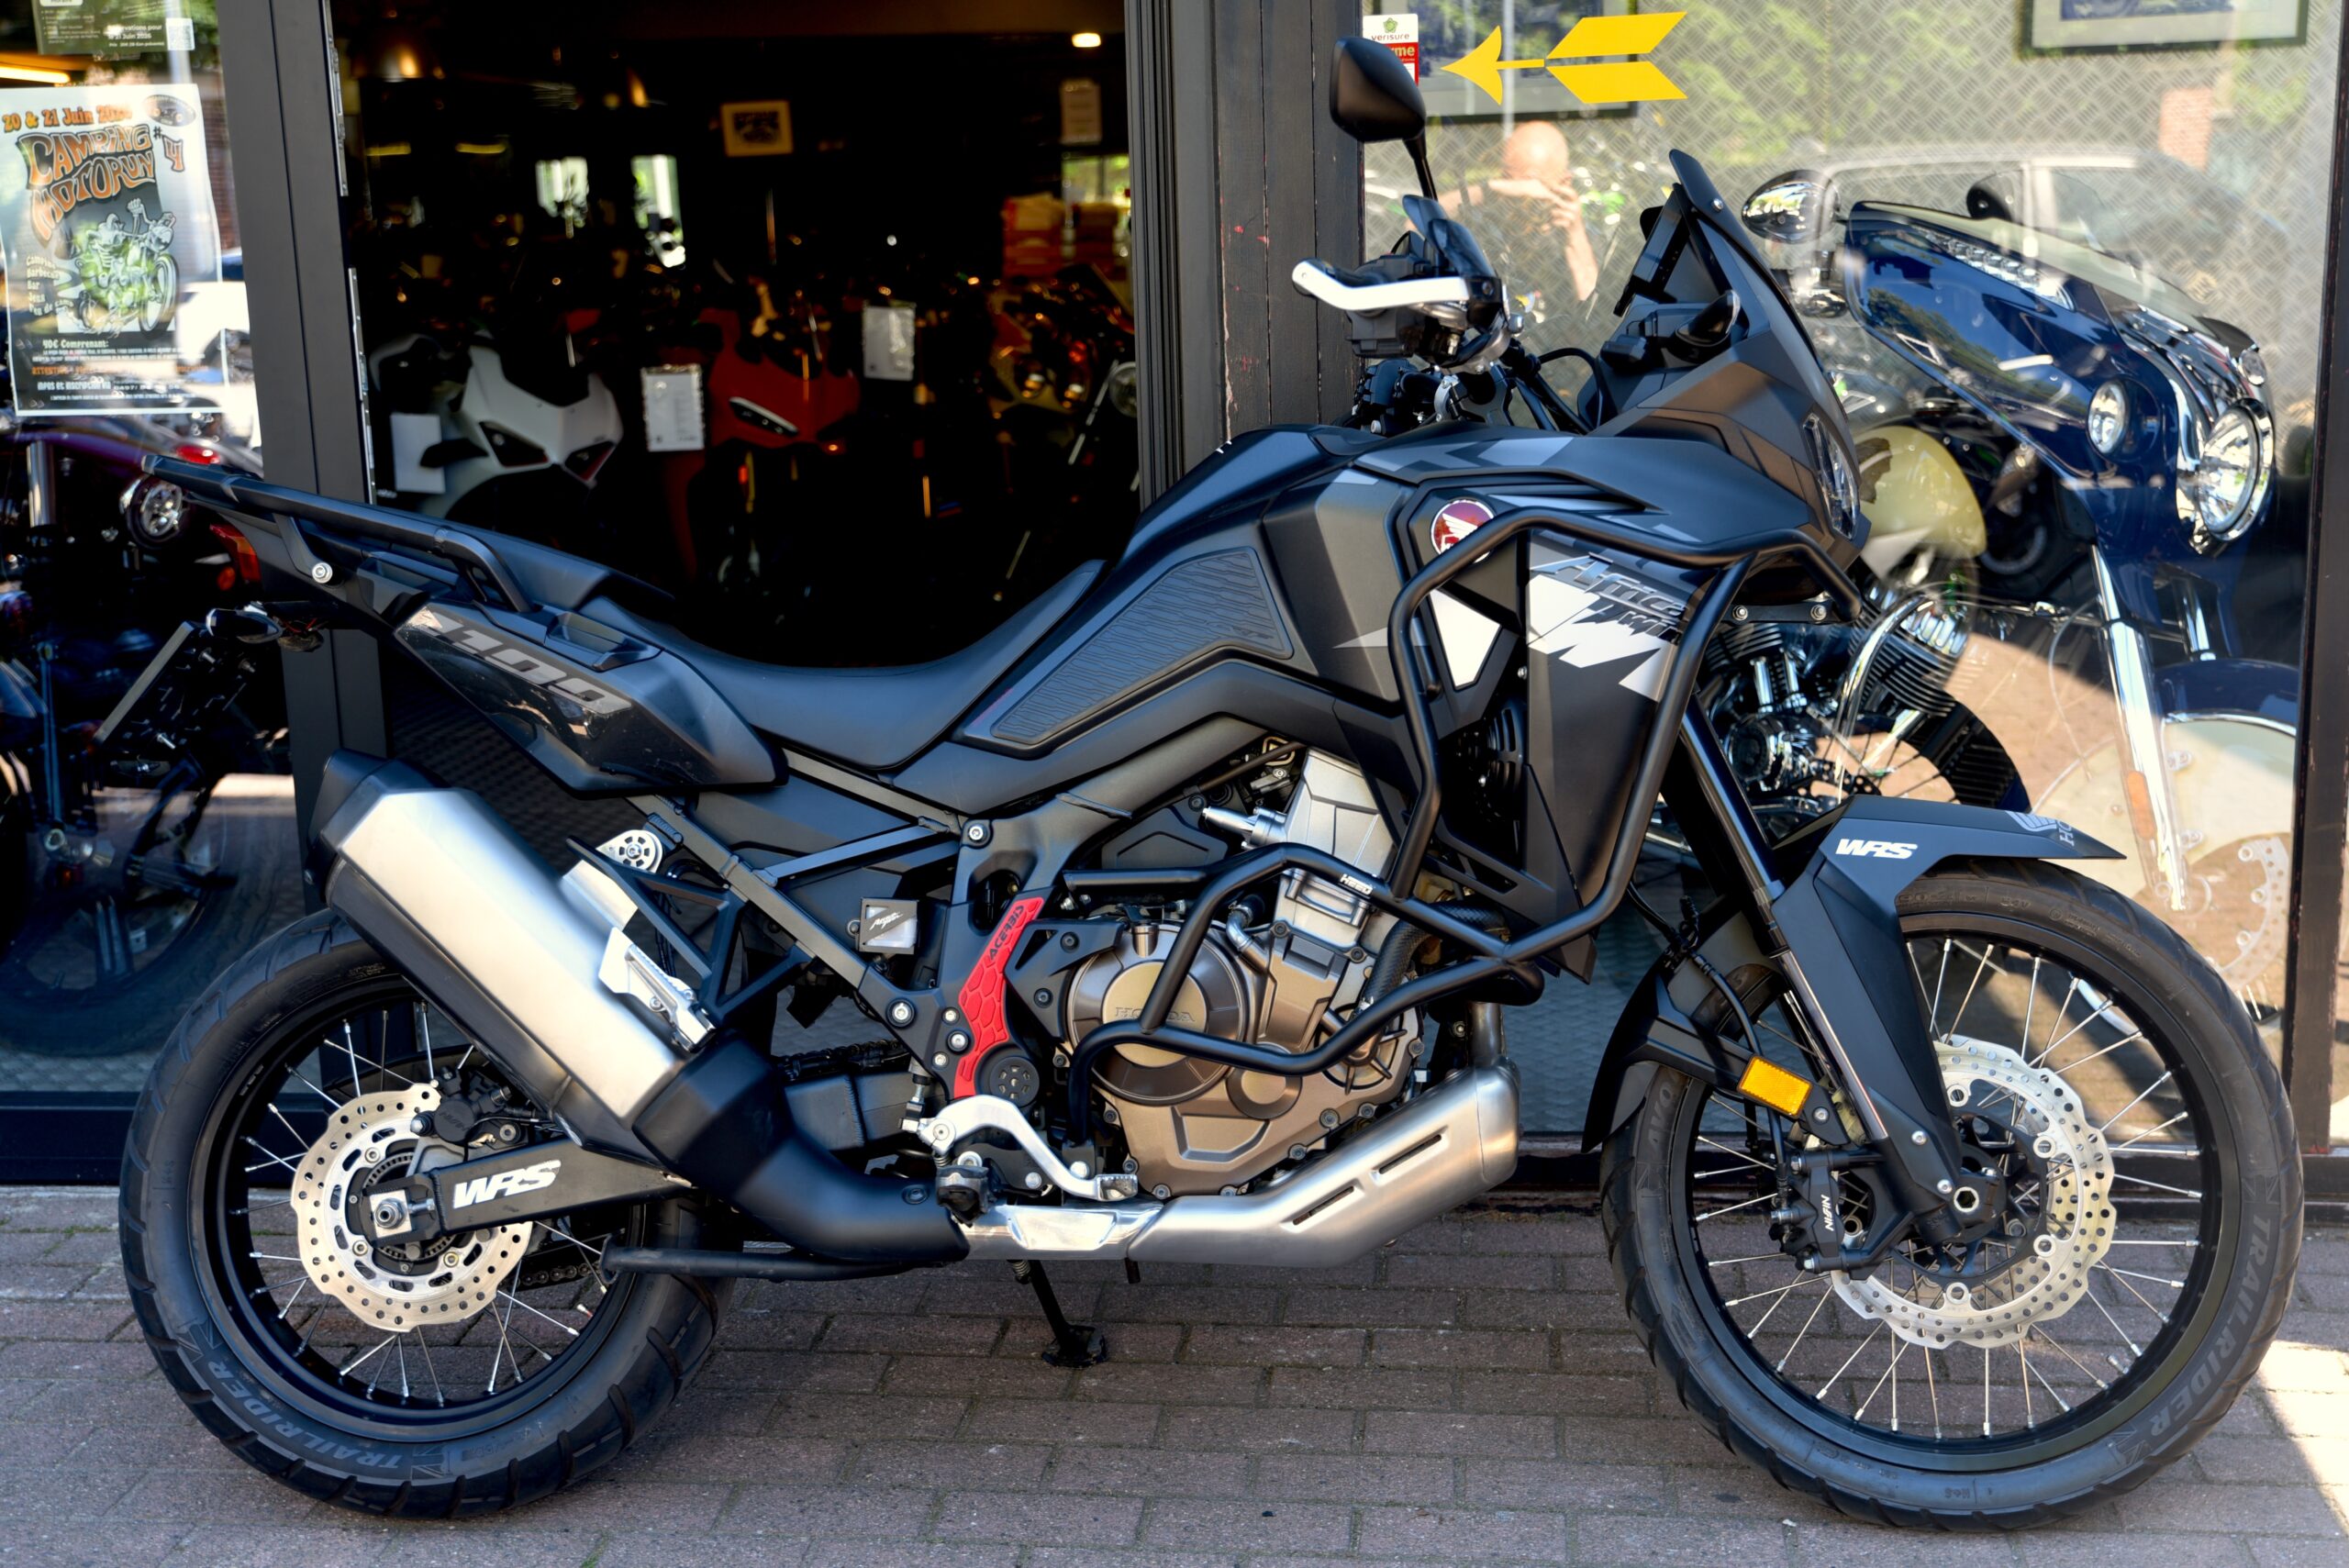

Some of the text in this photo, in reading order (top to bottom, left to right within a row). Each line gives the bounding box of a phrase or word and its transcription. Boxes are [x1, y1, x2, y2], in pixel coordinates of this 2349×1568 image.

[1372, 33, 1410, 41] verisure
[2, 114, 21, 133] 20
[25, 111, 39, 128] &
[42, 108, 60, 127] 21
[62, 107, 94, 126] Juin
[31, 150, 156, 241] MOTORUN
[1530, 551, 1689, 619] Africa
[1834, 839, 1919, 860] WRS
[988, 905, 1025, 961] ACERBIS
[1115, 1006, 1196, 1023] HODA
[453, 1159, 562, 1209] WRS
[2150, 1213, 2272, 1437] TRAILRIDER
[207, 1361, 403, 1470] TRAILRIDER
